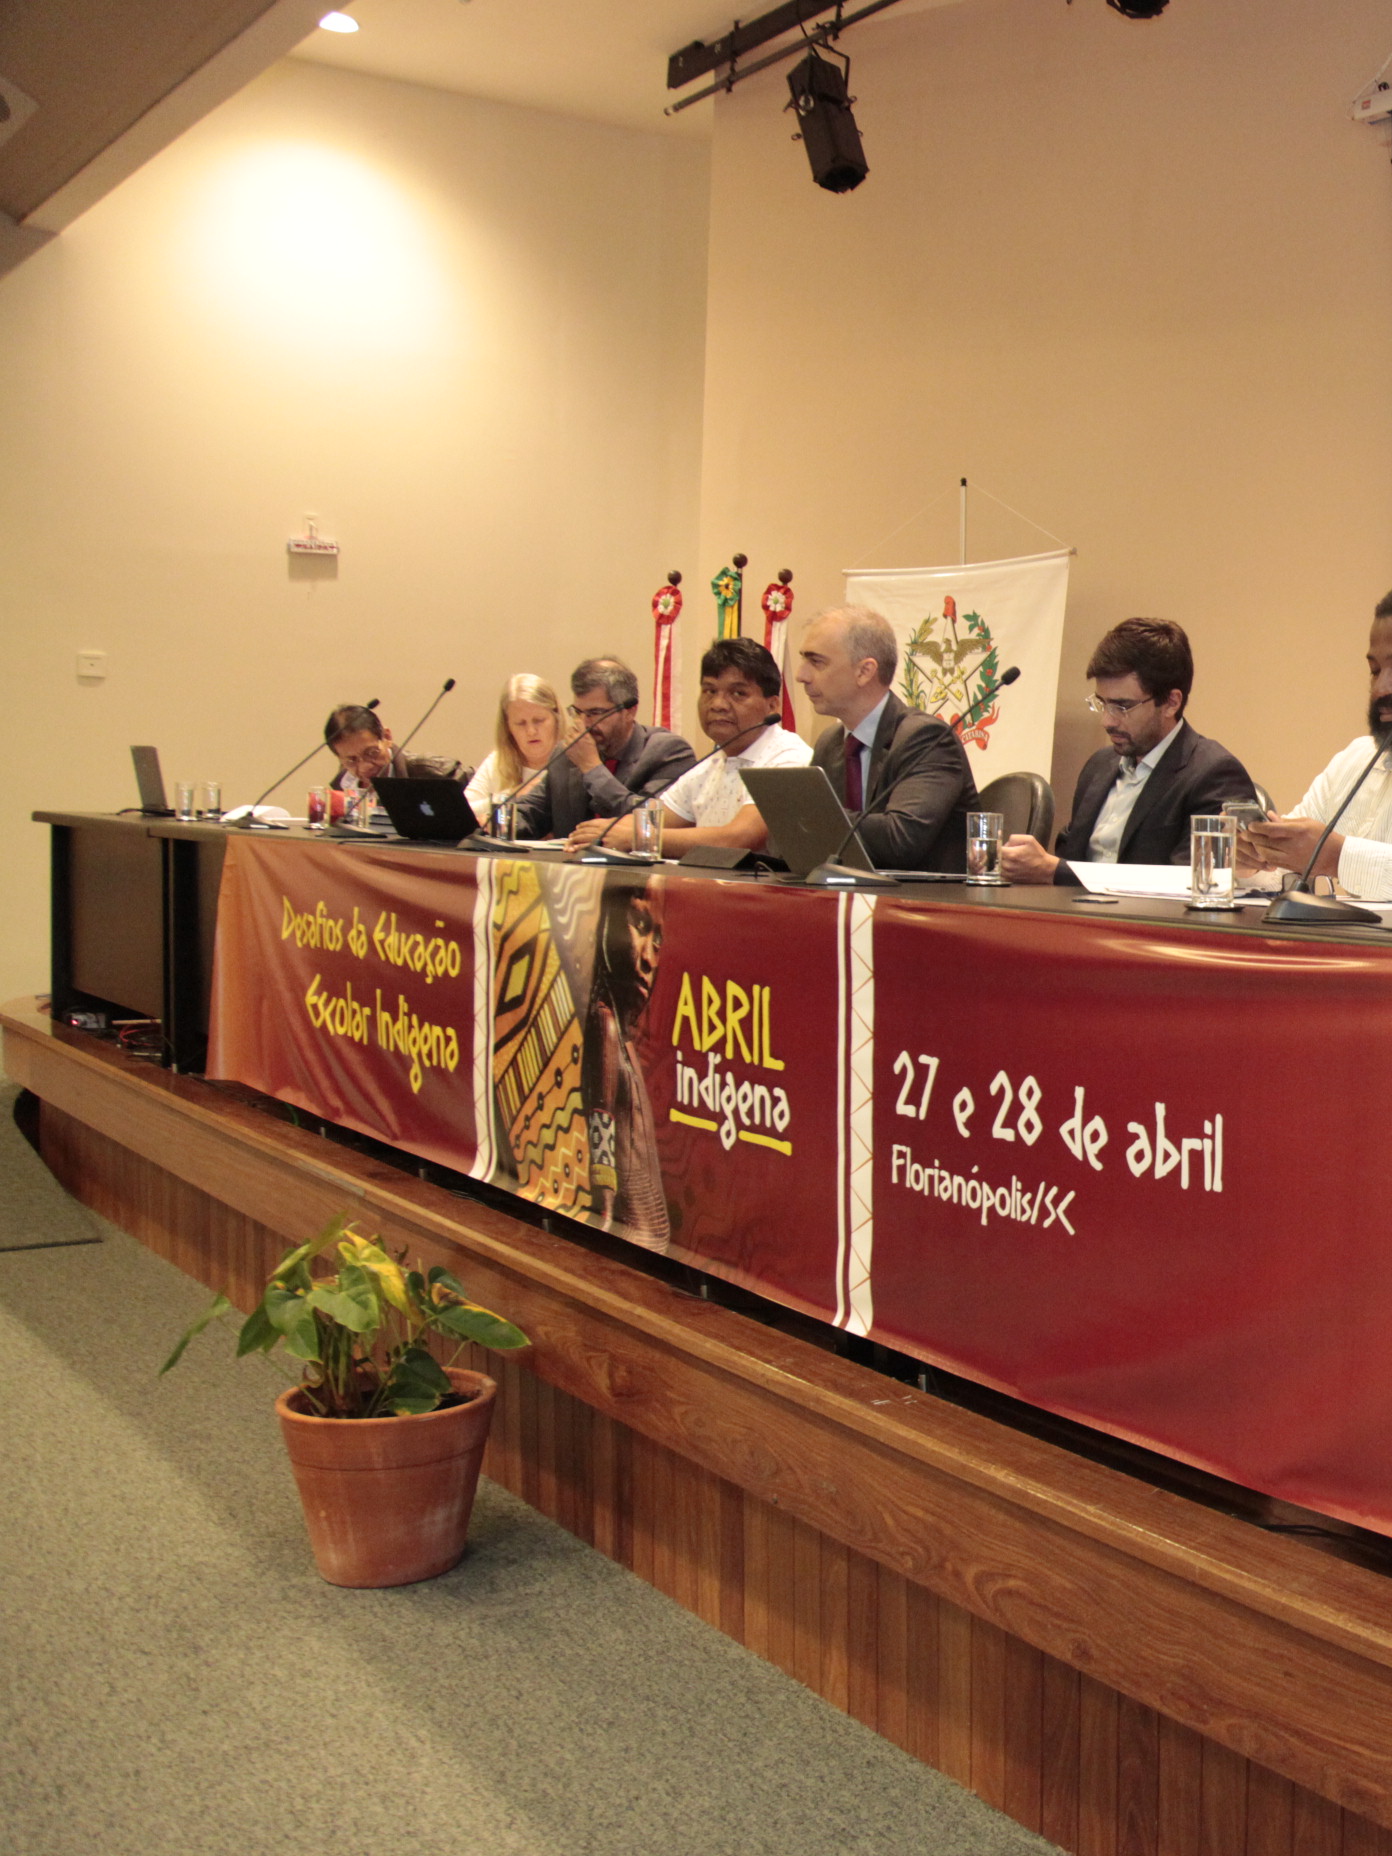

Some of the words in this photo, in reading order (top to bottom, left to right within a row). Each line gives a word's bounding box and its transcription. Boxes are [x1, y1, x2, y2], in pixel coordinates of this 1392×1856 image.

[281, 896, 343, 952] Desafios
[347, 906, 368, 958] da
[372, 909, 460, 983] Educação
[304, 973, 372, 1045] Escolar
[671, 971, 785, 1071] ABRIL
[675, 1050, 790, 1150] indígena
[893, 1050, 939, 1120] 27
[952, 1086, 975, 1137] e
[989, 1069, 1042, 1145] 28
[1059, 1085, 1108, 1170] de
[1126, 1101, 1223, 1193] abril
[891, 1143, 1076, 1235] Florianópolis/SC
